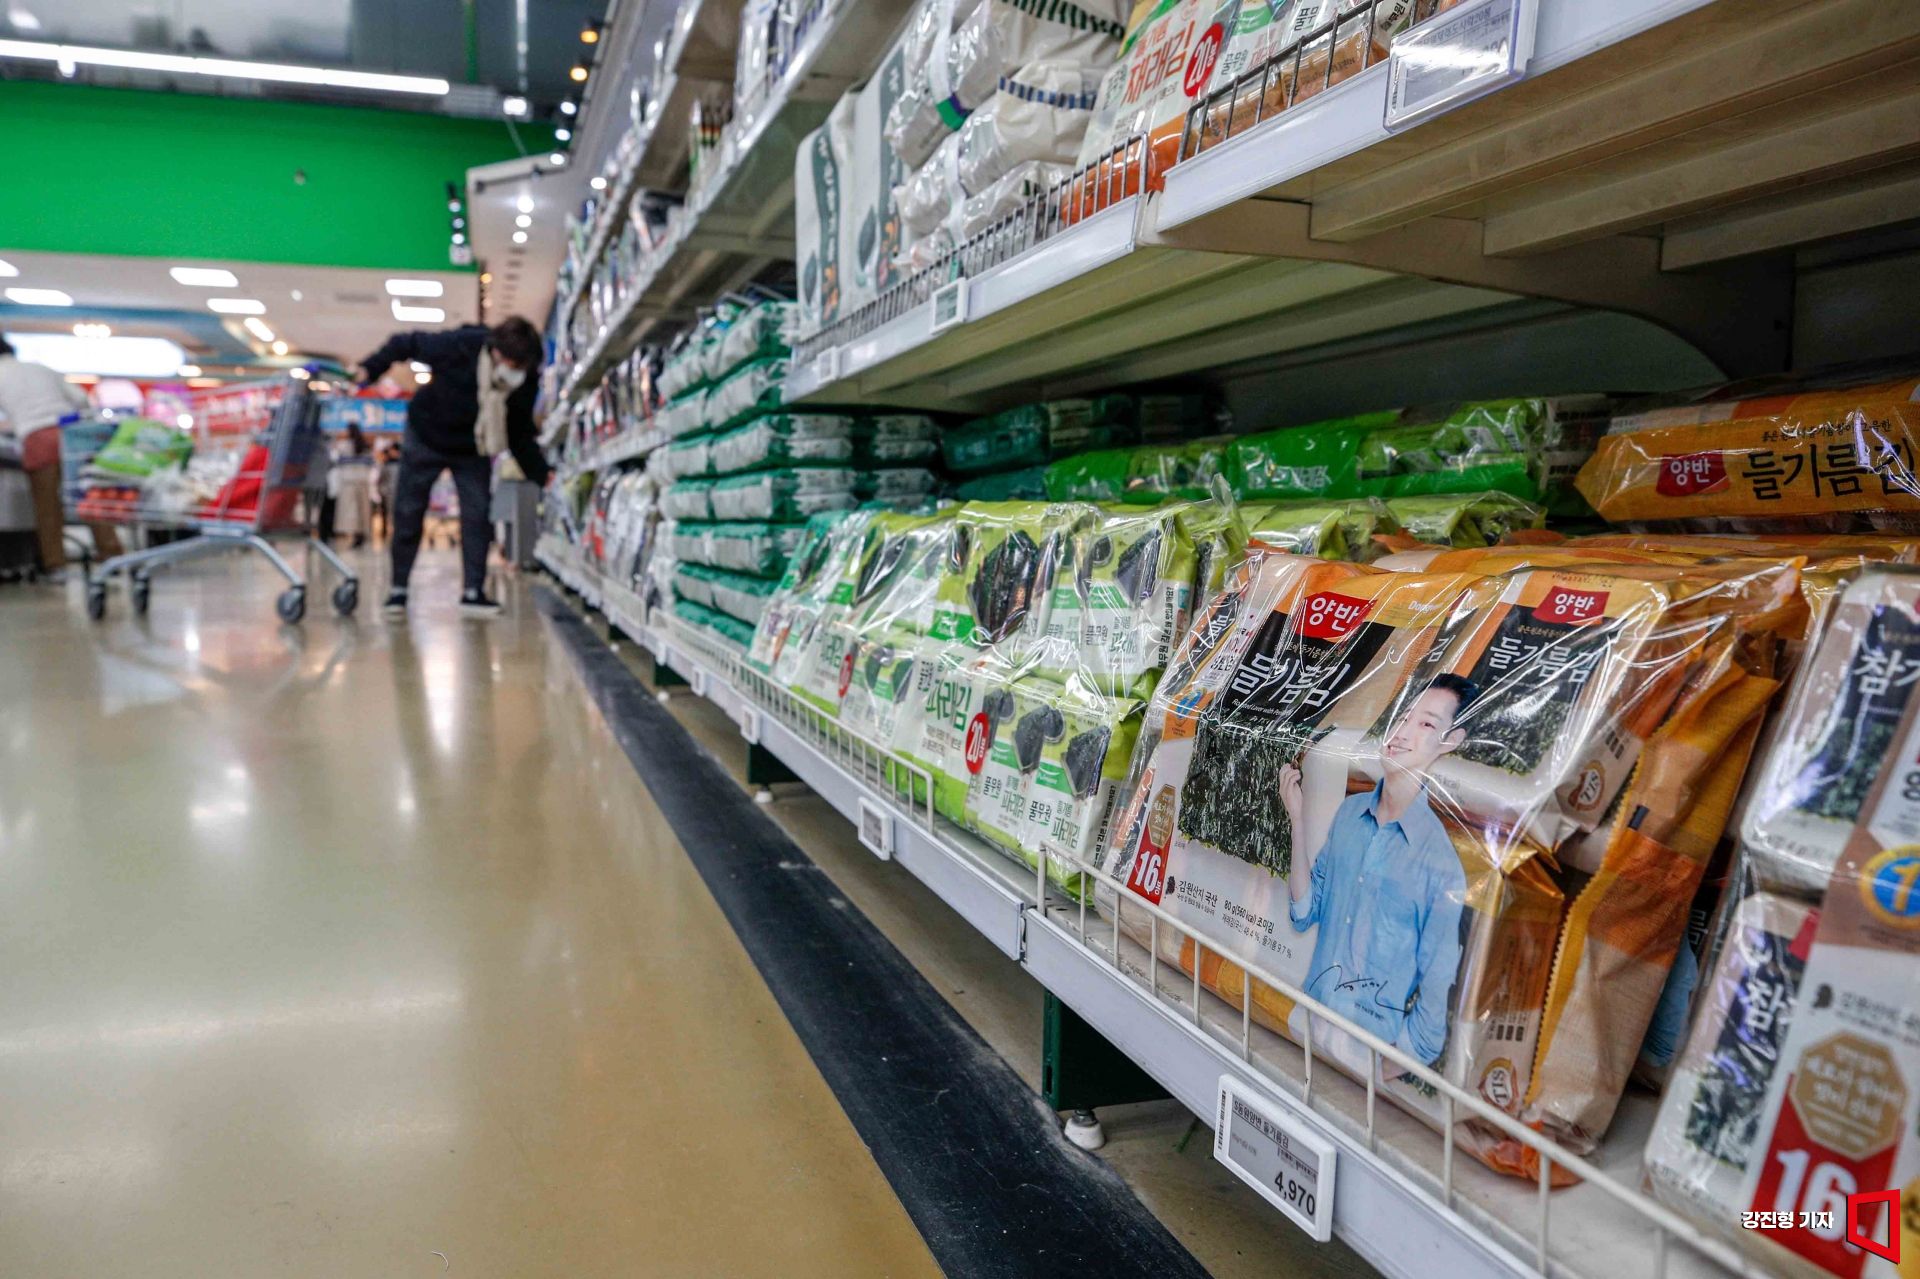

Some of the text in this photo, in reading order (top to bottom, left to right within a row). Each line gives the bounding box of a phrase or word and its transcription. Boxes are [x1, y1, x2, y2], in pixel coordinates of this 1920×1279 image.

[1293, 6, 1319, 31] 풀무
[1120, 20, 1196, 108] 재래김
[1670, 457, 1711, 487] 양반
[1742, 437, 1916, 500] 들기름김
[1310, 597, 1360, 632] 양반
[1554, 592, 1595, 617] 양반
[1489, 635, 1601, 684] 들기름김
[1231, 652, 1351, 707] 들기름김
[1029, 800, 1052, 823] 풀무원
[1051, 816, 1081, 849] 파래김
[1224, 899, 1232, 911] 80
[1256, 916, 1275, 935] 조미김
[1263, 1120, 1289, 1149] 들기름김
[1274, 1171, 1316, 1217] 4,970
